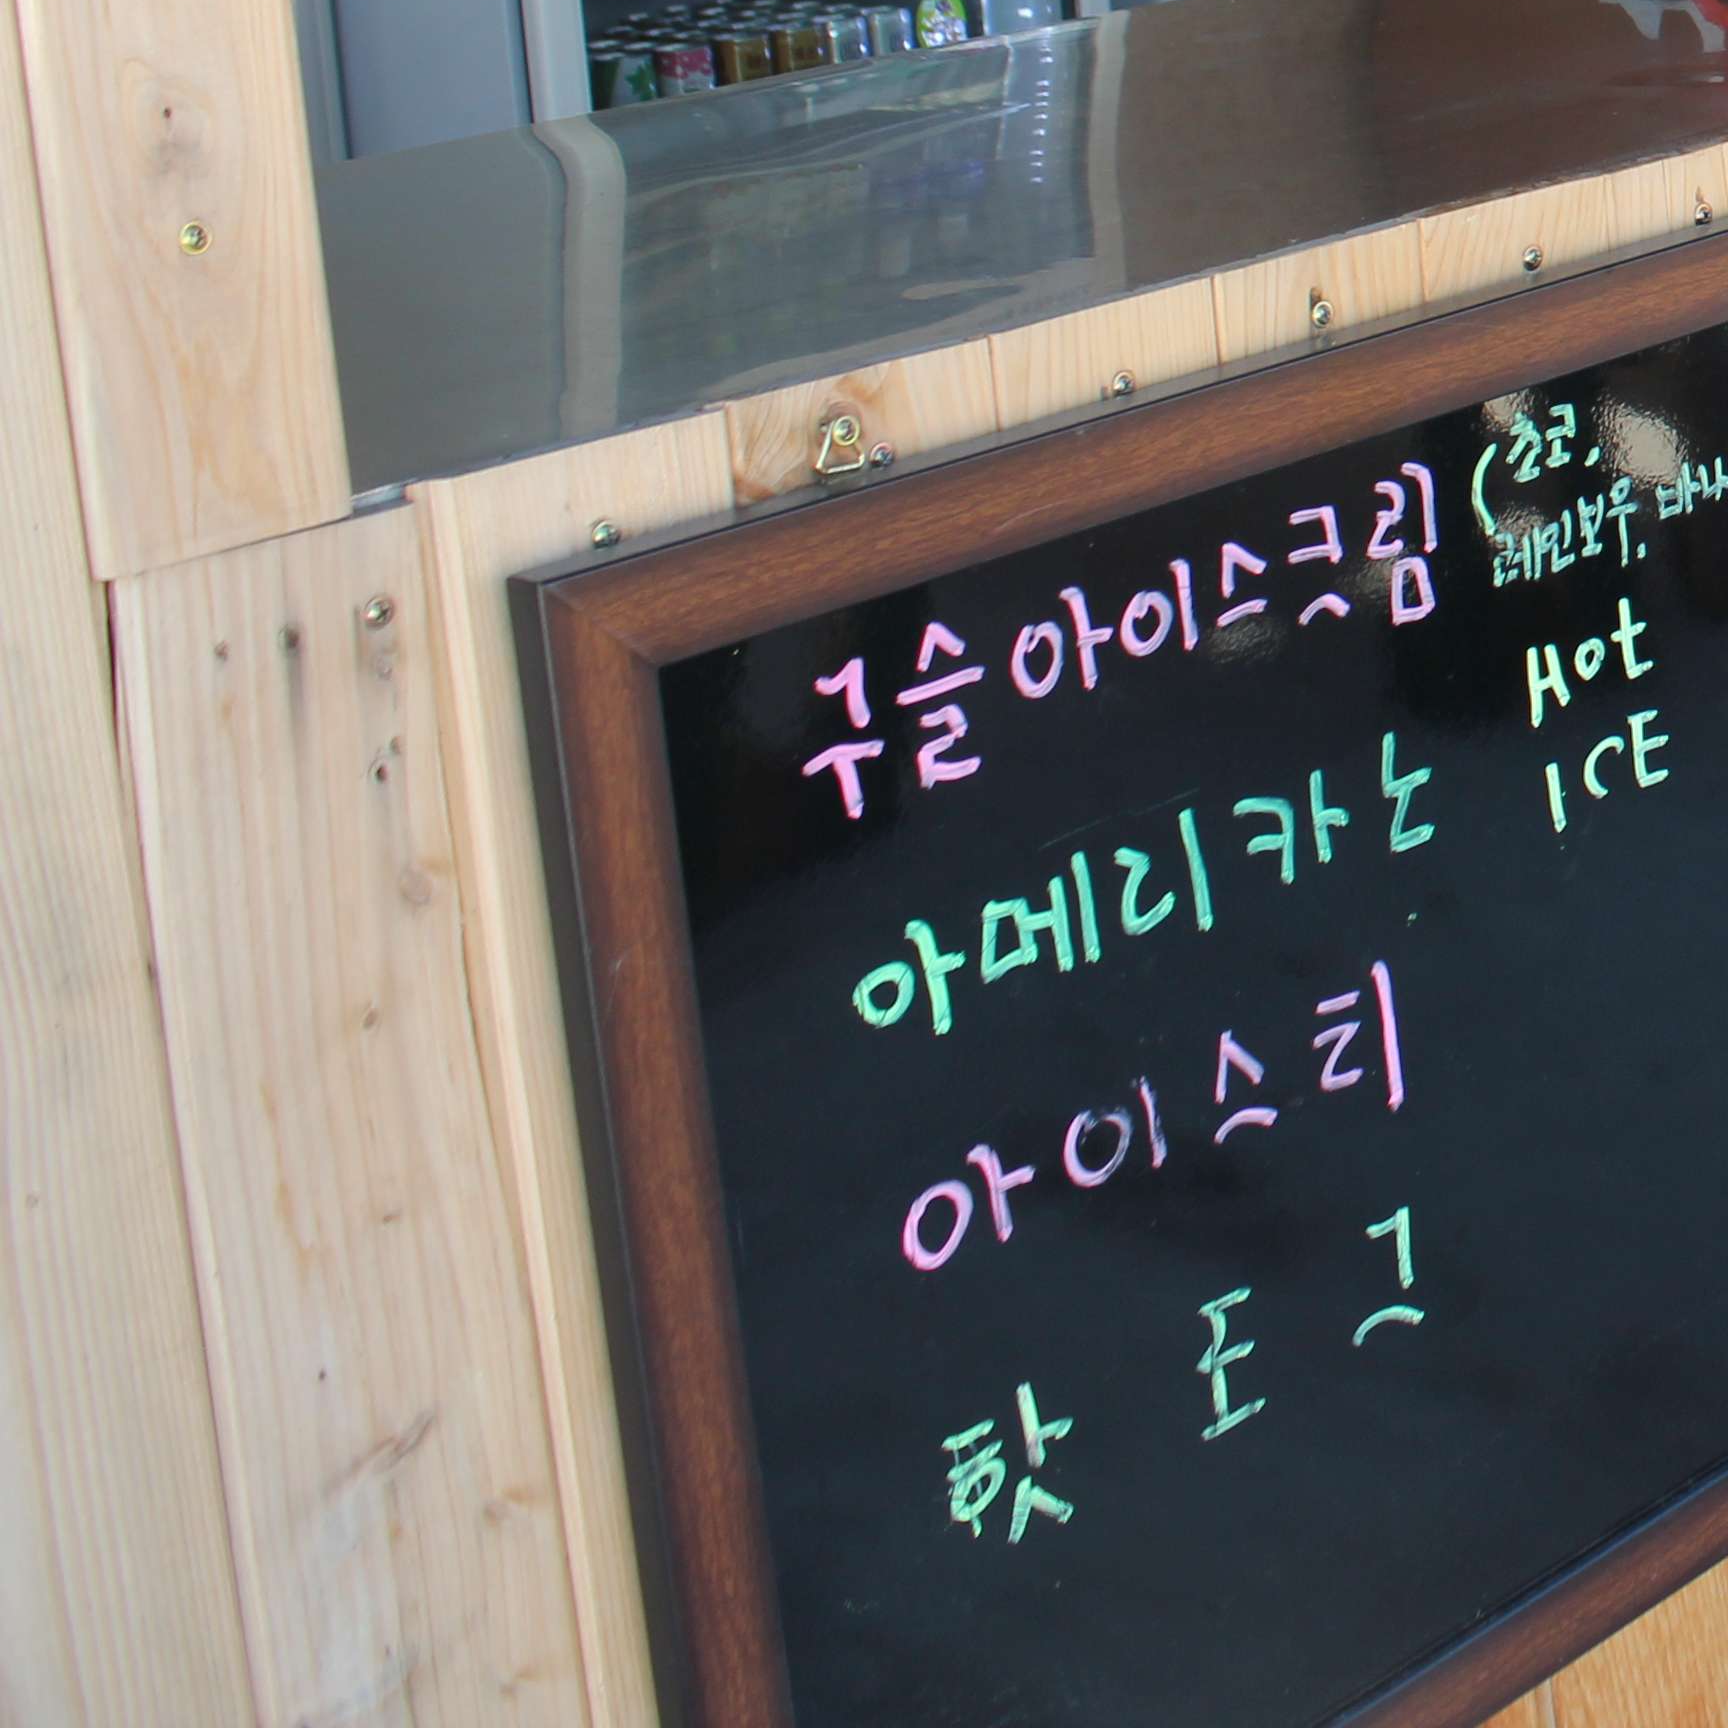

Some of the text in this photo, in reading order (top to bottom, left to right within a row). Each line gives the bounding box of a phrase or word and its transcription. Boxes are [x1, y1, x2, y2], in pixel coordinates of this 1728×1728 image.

[803, 462, 1438, 819] 구슬아이스크림
[1545, 709, 1669, 834] ICE
[852, 597, 1659, 1036] 아메리카노 Hot
[902, 960, 1405, 1271] 아이스티
